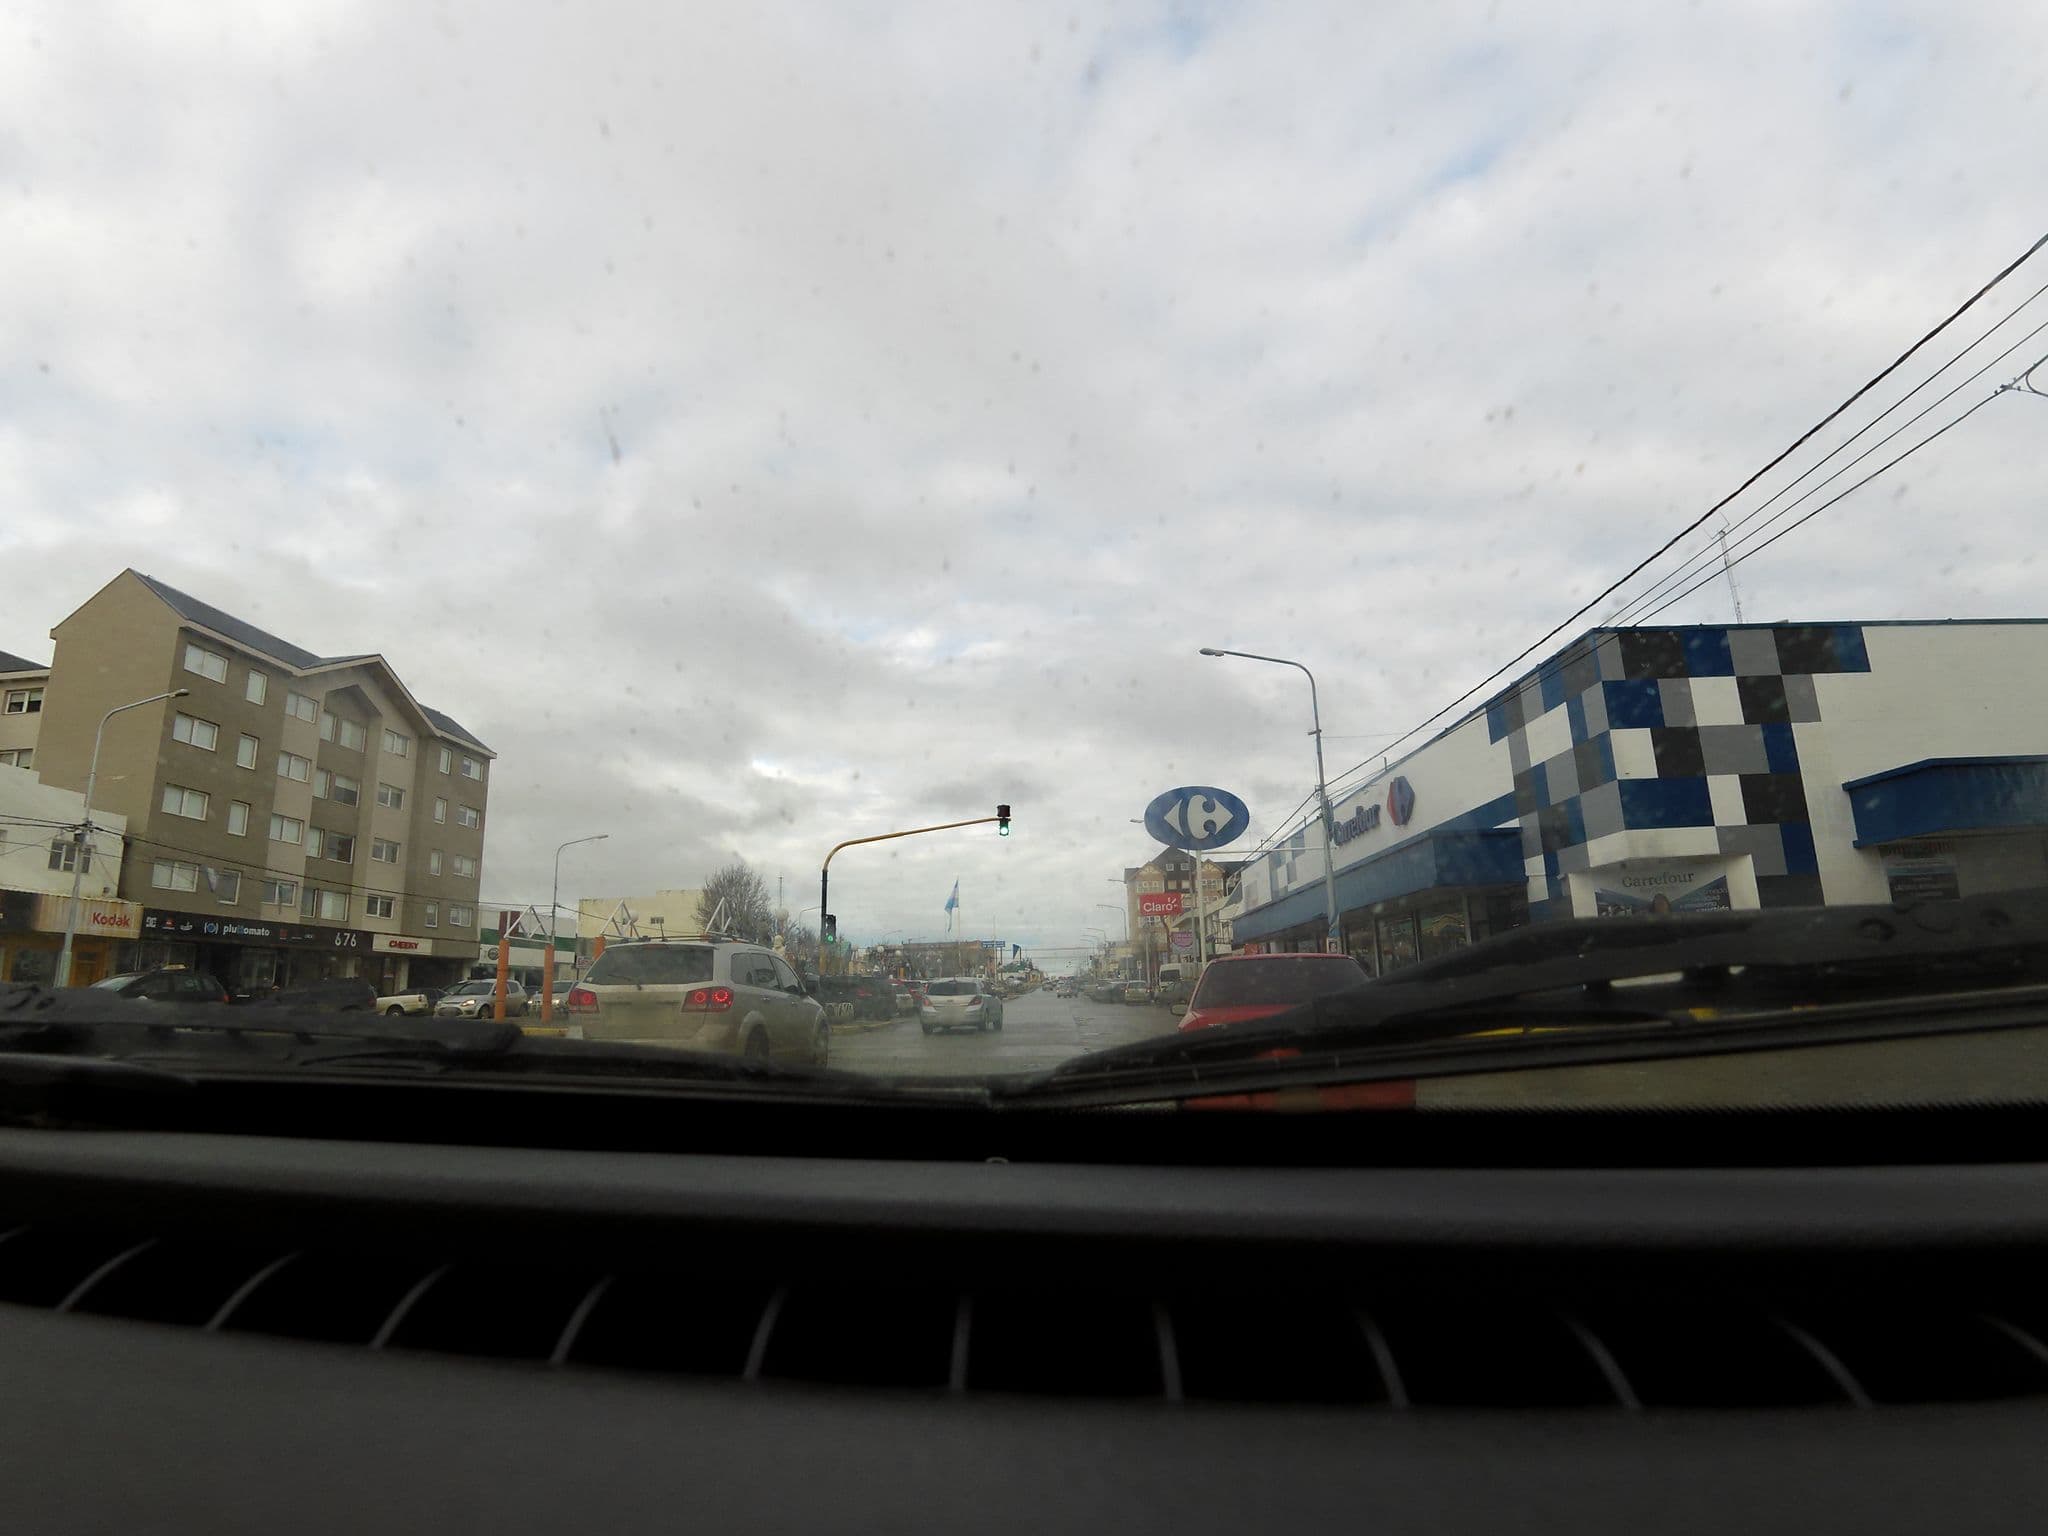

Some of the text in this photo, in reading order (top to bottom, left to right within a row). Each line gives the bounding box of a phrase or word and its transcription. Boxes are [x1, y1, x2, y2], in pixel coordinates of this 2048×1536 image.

[1621, 871, 1695, 888] Carrefour
[1142, 901, 1173, 912] Claro
[92, 911, 131, 928] Kodak
[334, 932, 358, 948] 676
